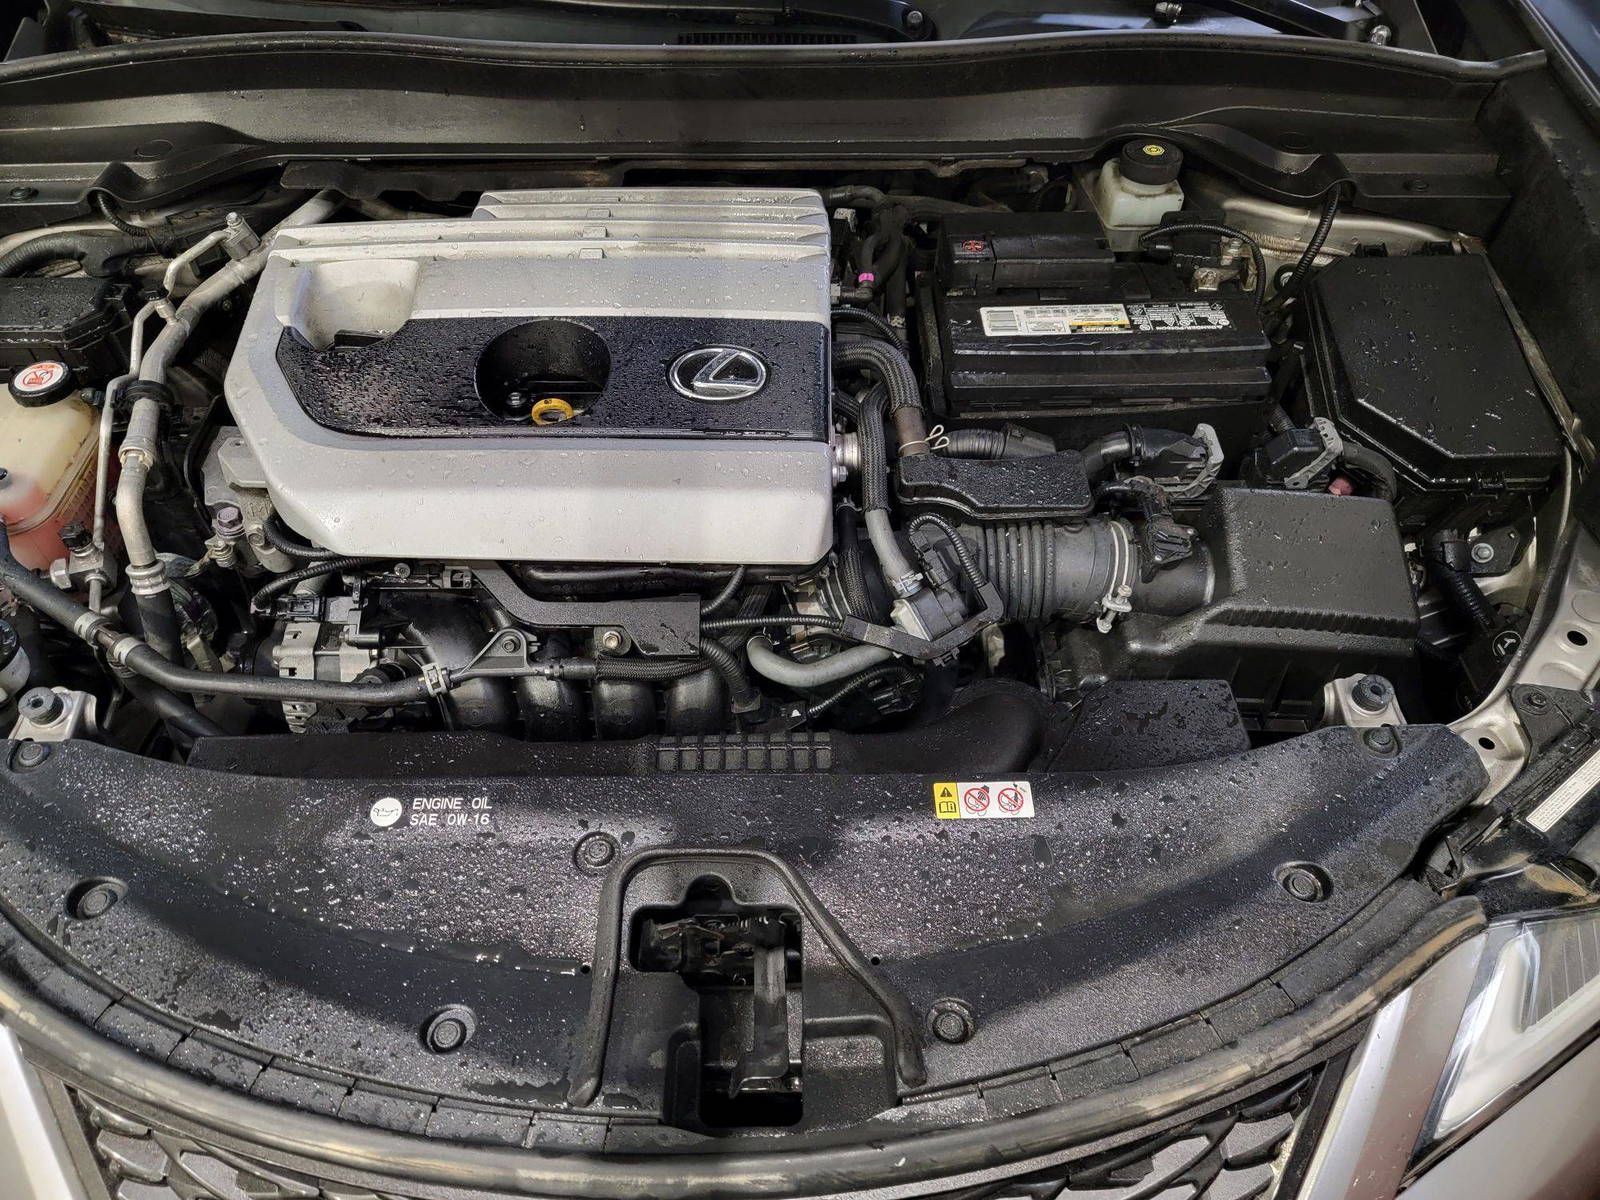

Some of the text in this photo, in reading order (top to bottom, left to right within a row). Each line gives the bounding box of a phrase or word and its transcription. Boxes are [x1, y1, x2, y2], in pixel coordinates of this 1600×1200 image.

[412, 797, 493, 810] ENGINE OIL
[410, 813, 490, 826] SAE 0W-16
